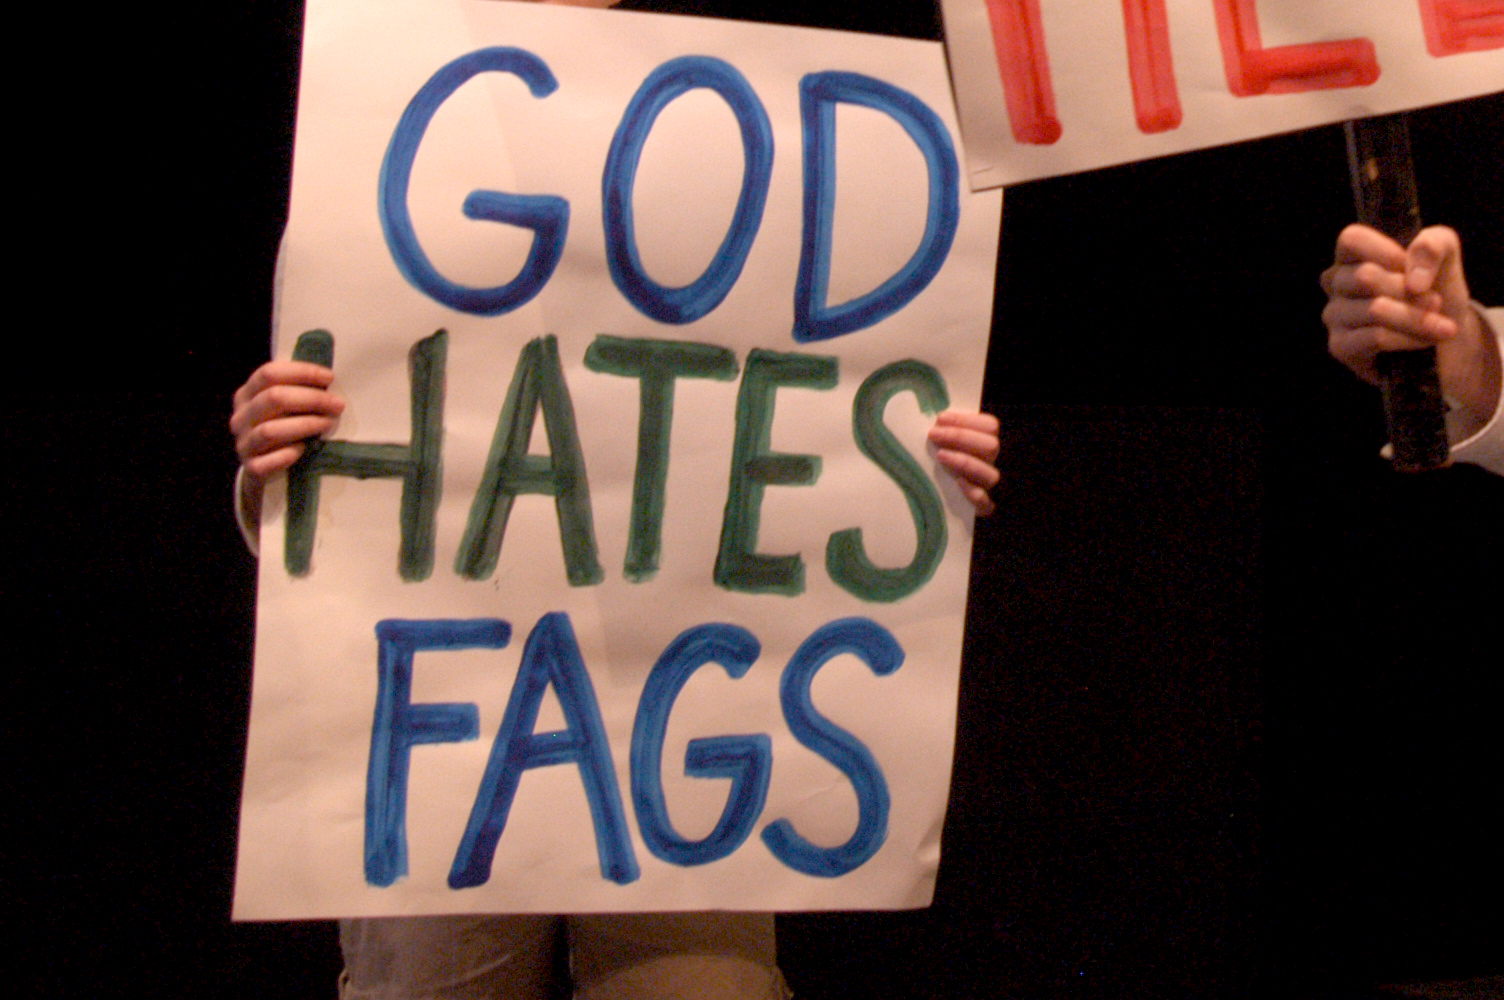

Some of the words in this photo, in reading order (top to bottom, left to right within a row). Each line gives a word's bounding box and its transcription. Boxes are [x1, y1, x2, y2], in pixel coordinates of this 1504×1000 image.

[377, 45, 960, 343] GOD
[284, 328, 950, 603] HATES
[364, 611, 906, 889] FAGS
